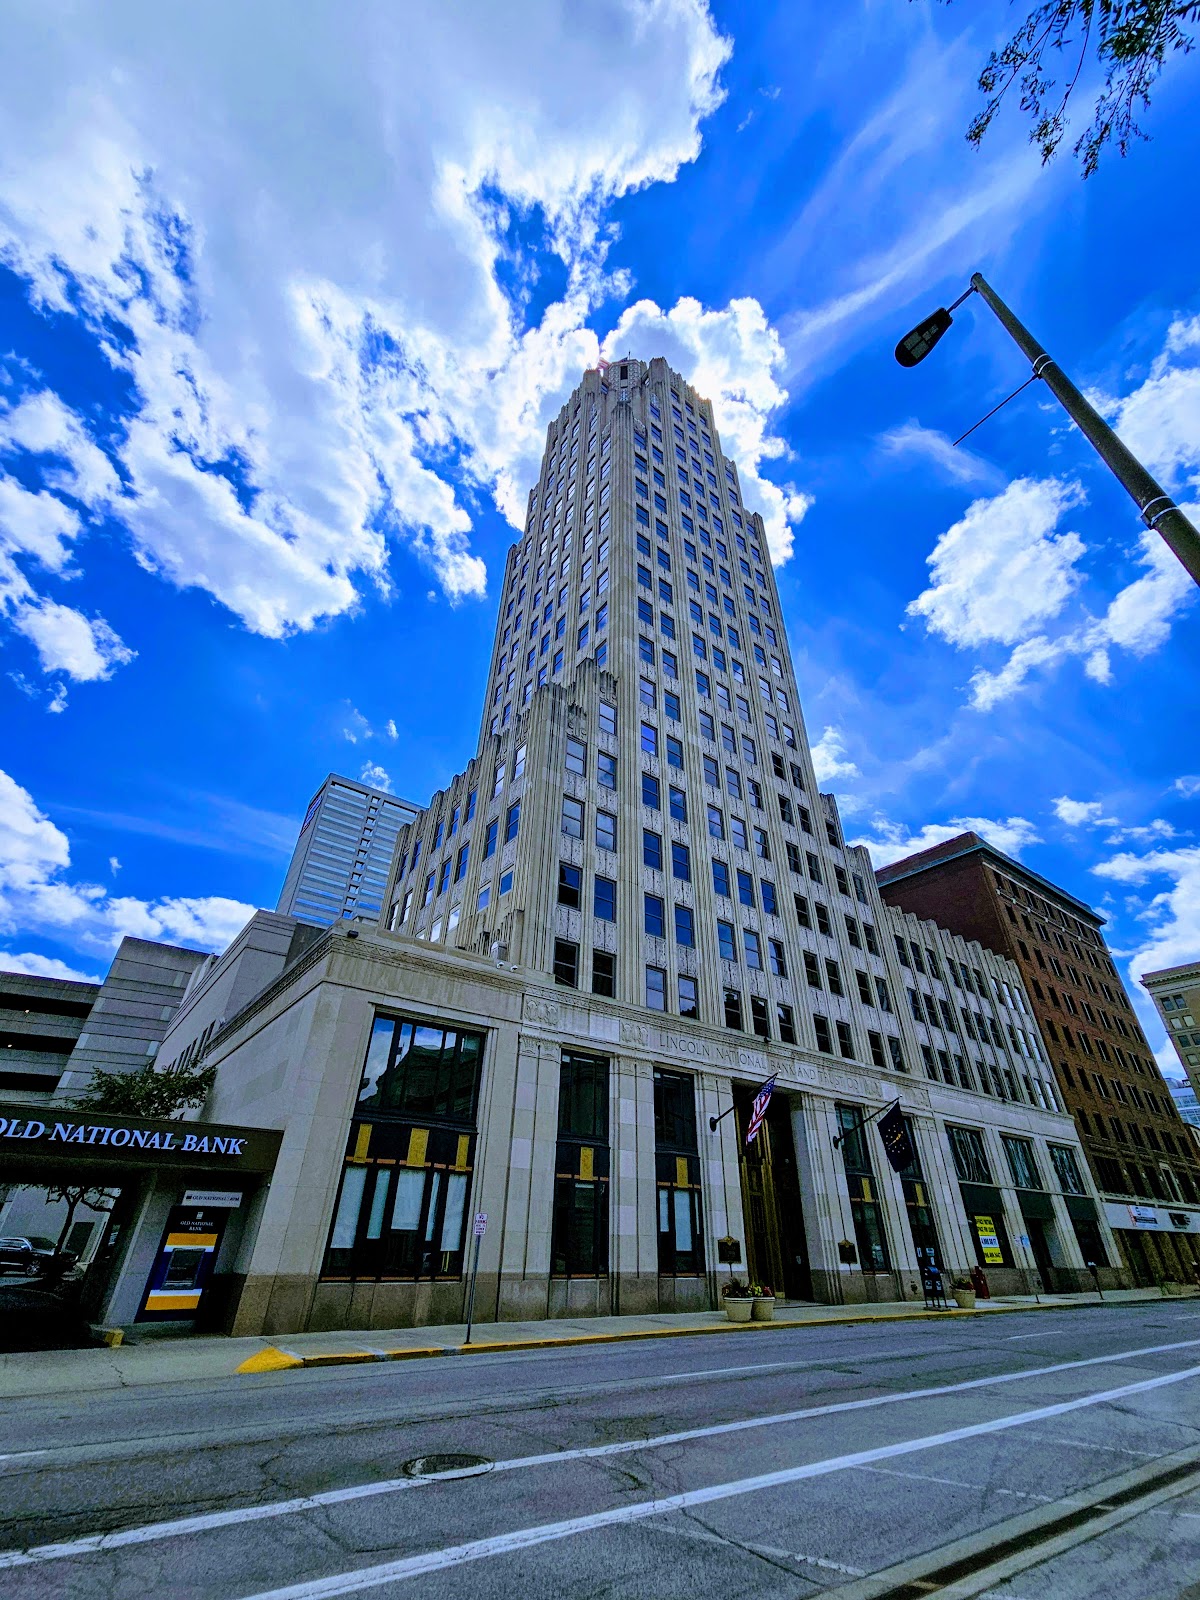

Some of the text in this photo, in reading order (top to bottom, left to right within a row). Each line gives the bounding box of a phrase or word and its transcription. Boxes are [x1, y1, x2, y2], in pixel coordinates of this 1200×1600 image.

[660, 1033, 710, 1056] LINCOLN
[716, 1047, 767, 1070] NATIONAL
[770, 1059, 796, 1075] BANK
[797, 1066, 817, 1080] AND
[818, 1070, 845, 1089] TRUST
[48, 1122, 176, 1150] NATIONAL
[181, 1134, 245, 1155] BANK
